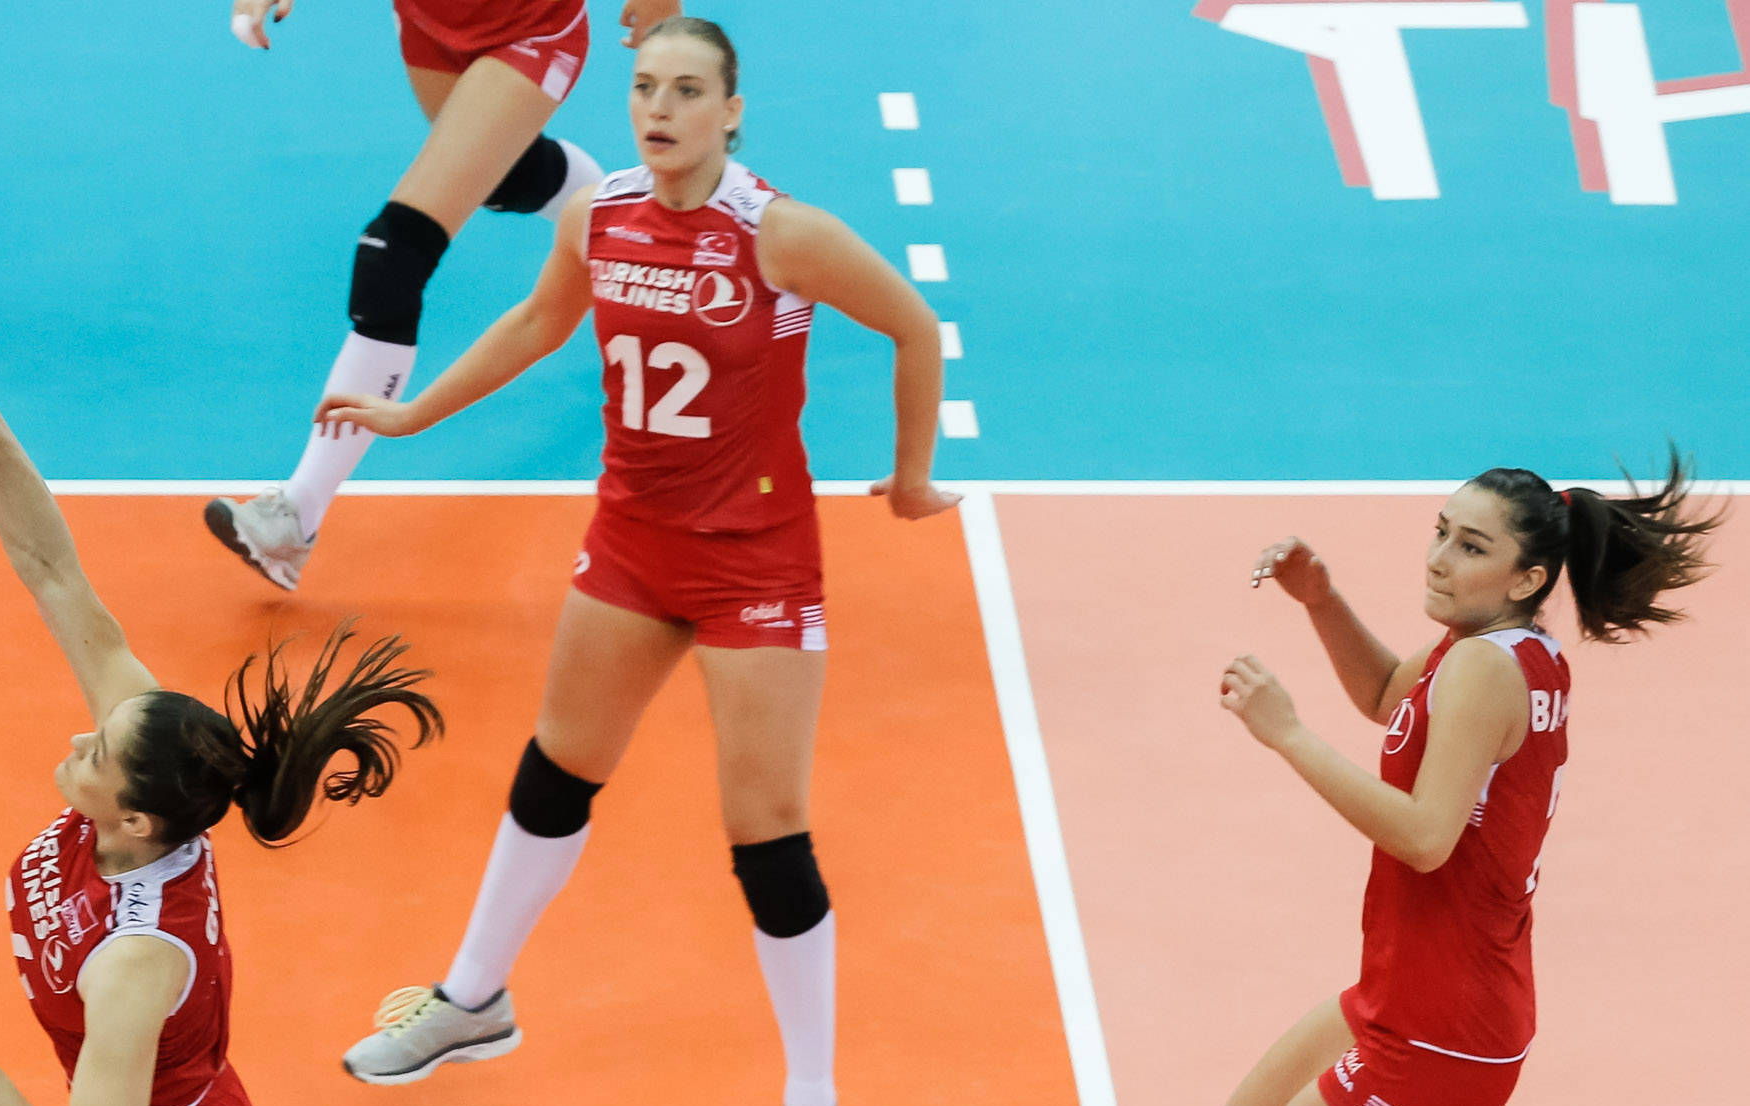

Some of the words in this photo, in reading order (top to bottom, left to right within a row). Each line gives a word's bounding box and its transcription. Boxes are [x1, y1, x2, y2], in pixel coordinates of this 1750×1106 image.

[592, 280, 693, 315] RLINES
[605, 334, 711, 439] 12
[20, 834, 51, 940] RLINES
[39, 806, 73, 931] URKISH
